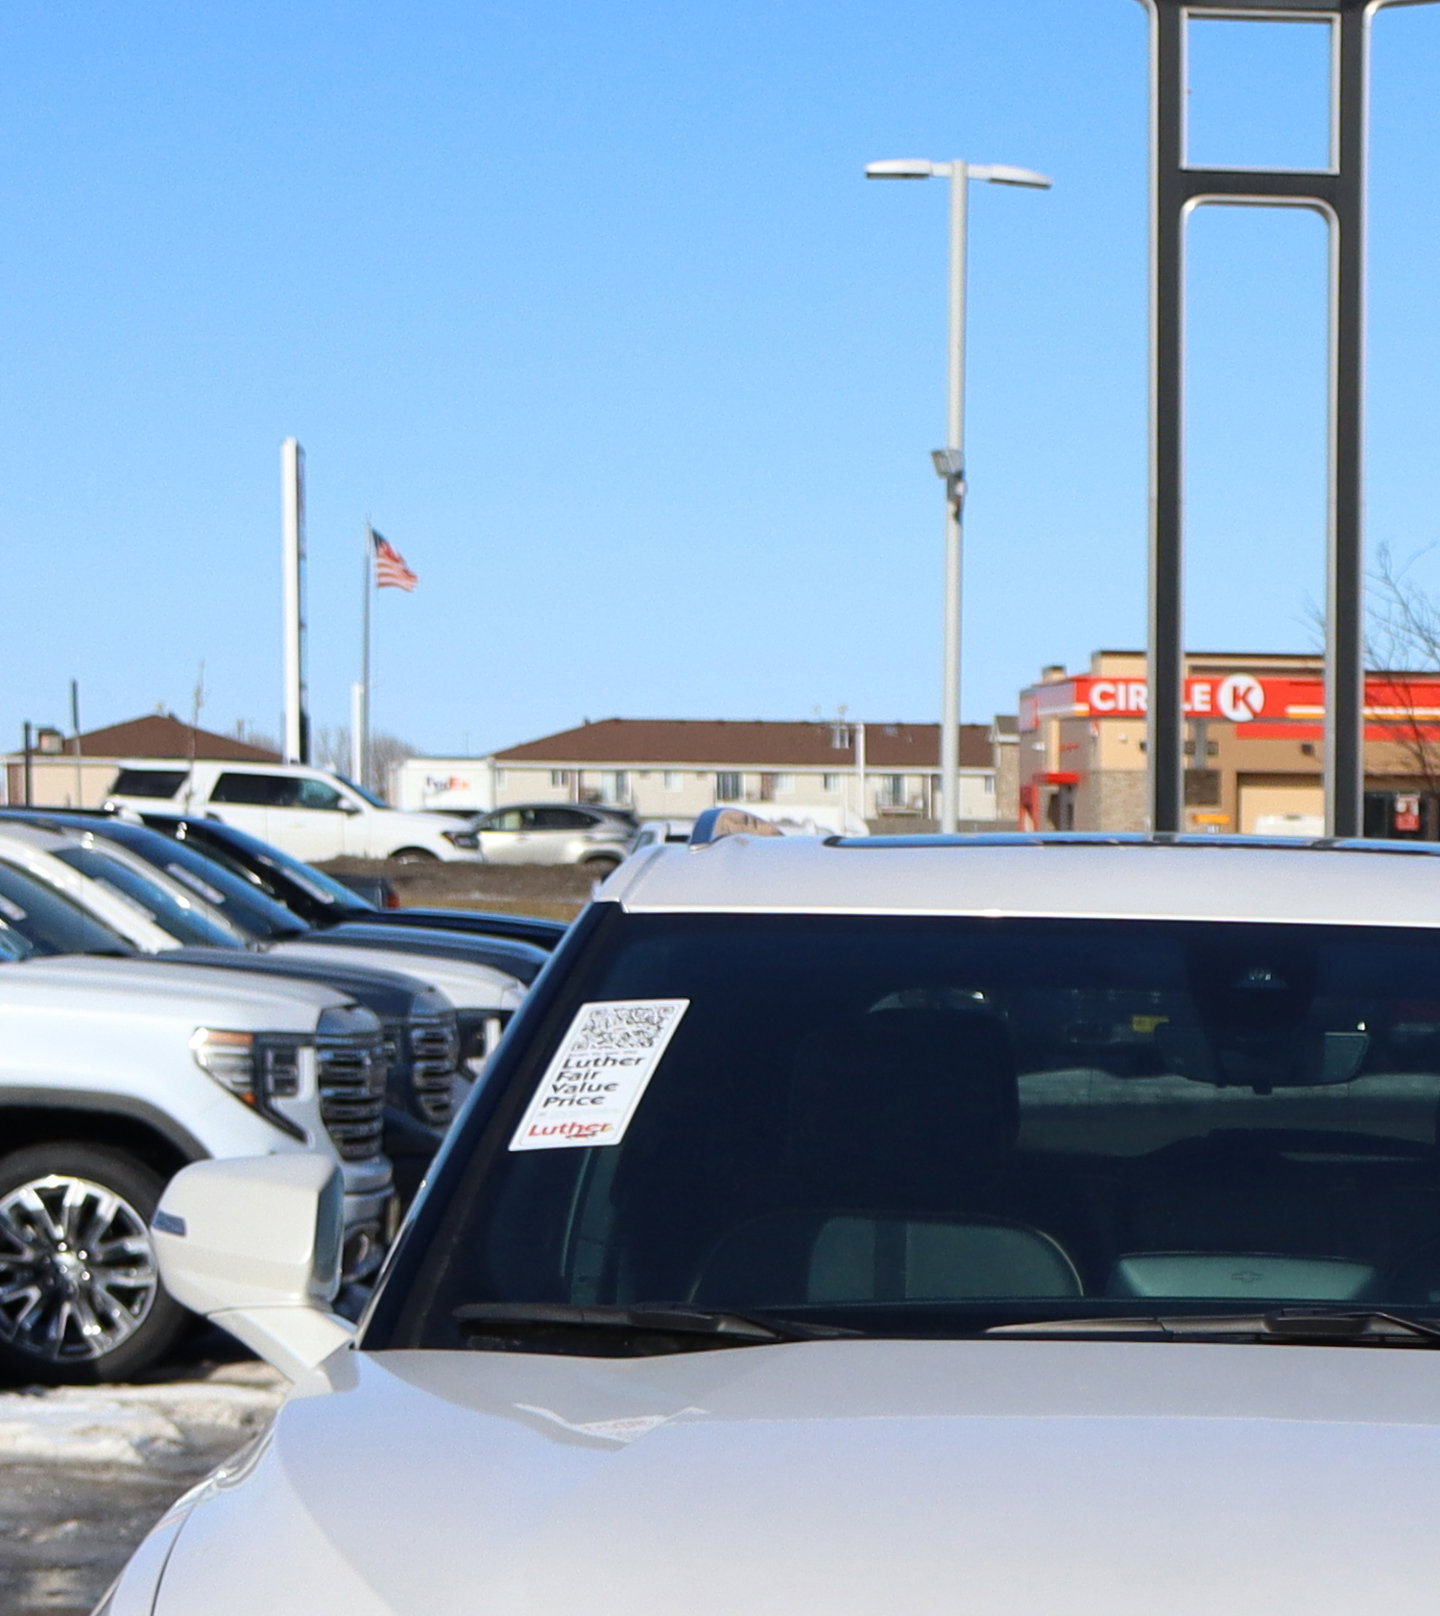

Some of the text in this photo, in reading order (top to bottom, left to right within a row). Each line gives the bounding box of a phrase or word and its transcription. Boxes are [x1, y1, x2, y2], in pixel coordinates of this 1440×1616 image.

[1090, 682, 1212, 711] CIRE
[562, 1056, 647, 1070] Luther
[555, 1070, 602, 1083] Fair
[552, 1082, 620, 1095] Value
[542, 1095, 606, 1109] Price
[528, 1122, 614, 1138] Luther
